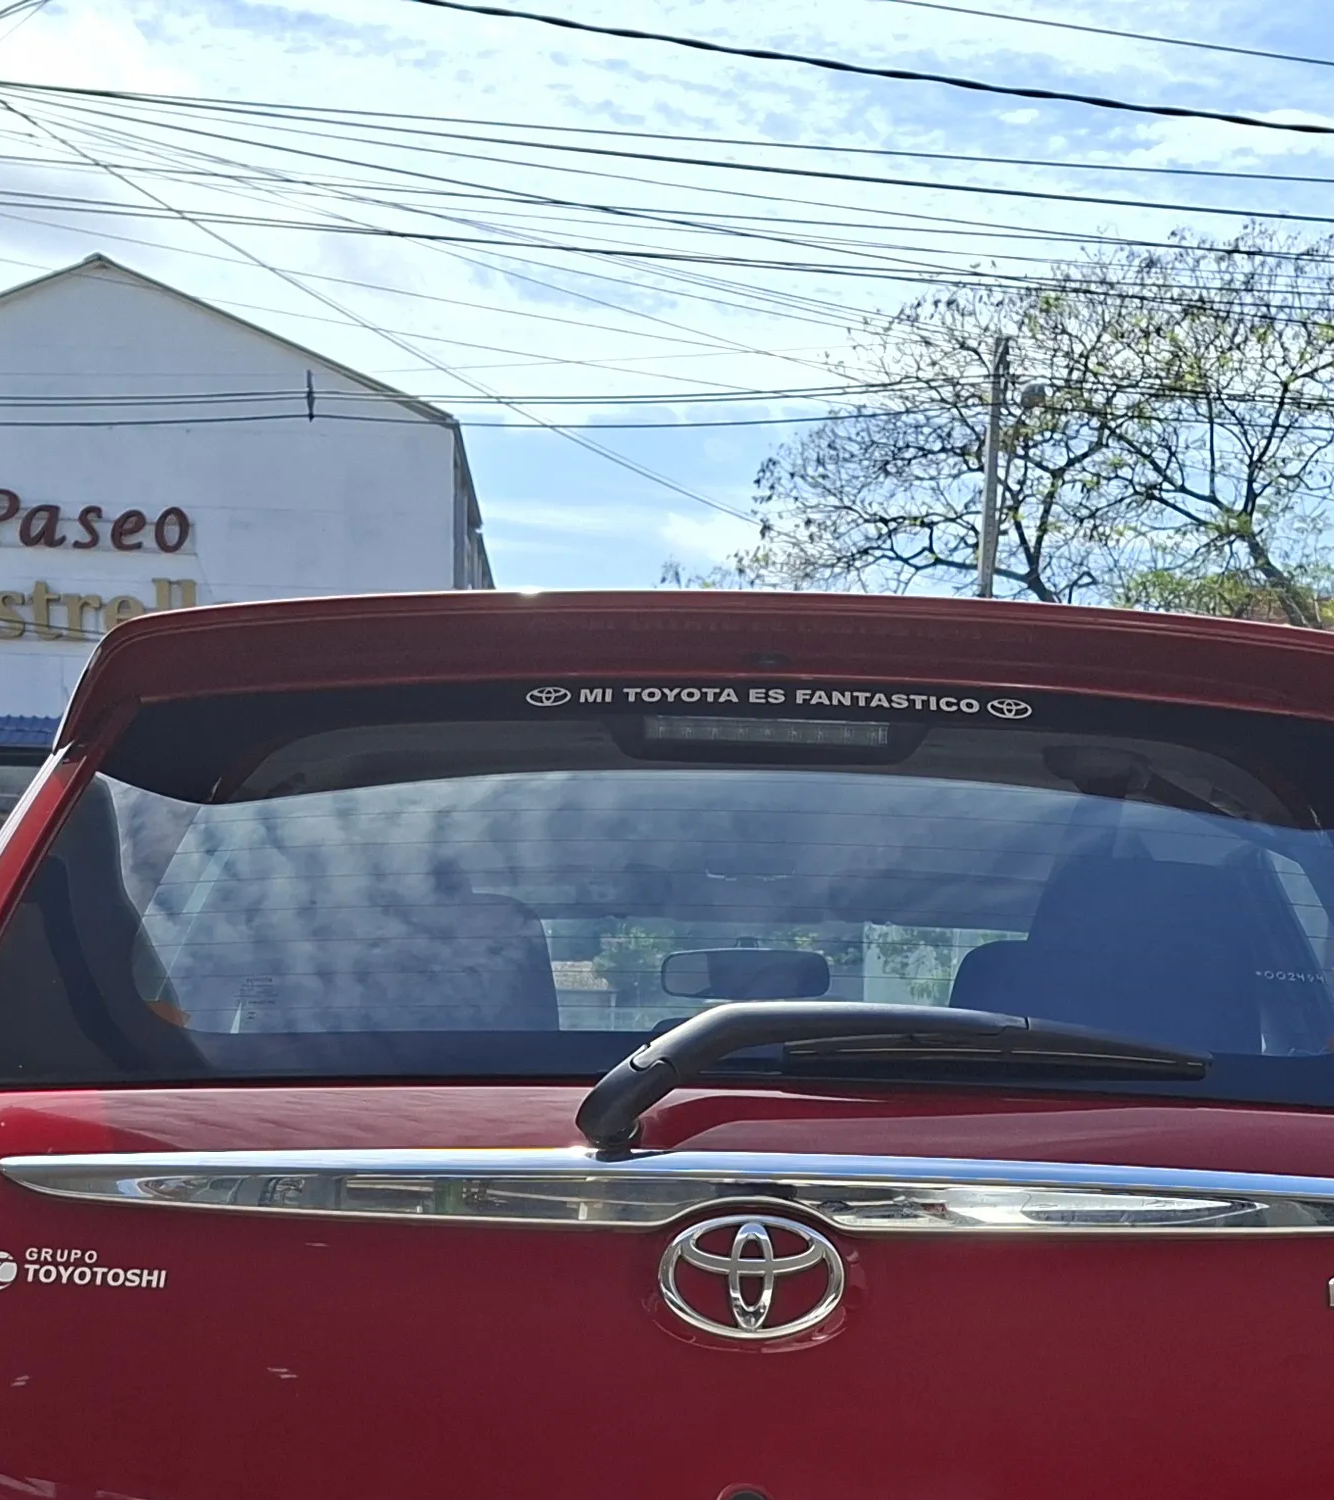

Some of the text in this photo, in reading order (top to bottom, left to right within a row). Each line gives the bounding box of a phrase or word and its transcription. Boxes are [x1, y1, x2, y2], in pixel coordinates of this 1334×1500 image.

[579, 687, 980, 714] MI TOYOTA ES FANTASTICO
[25, 1248, 98, 1264] GRUPO
[24, 1264, 167, 1289] TOYOTOSHI
